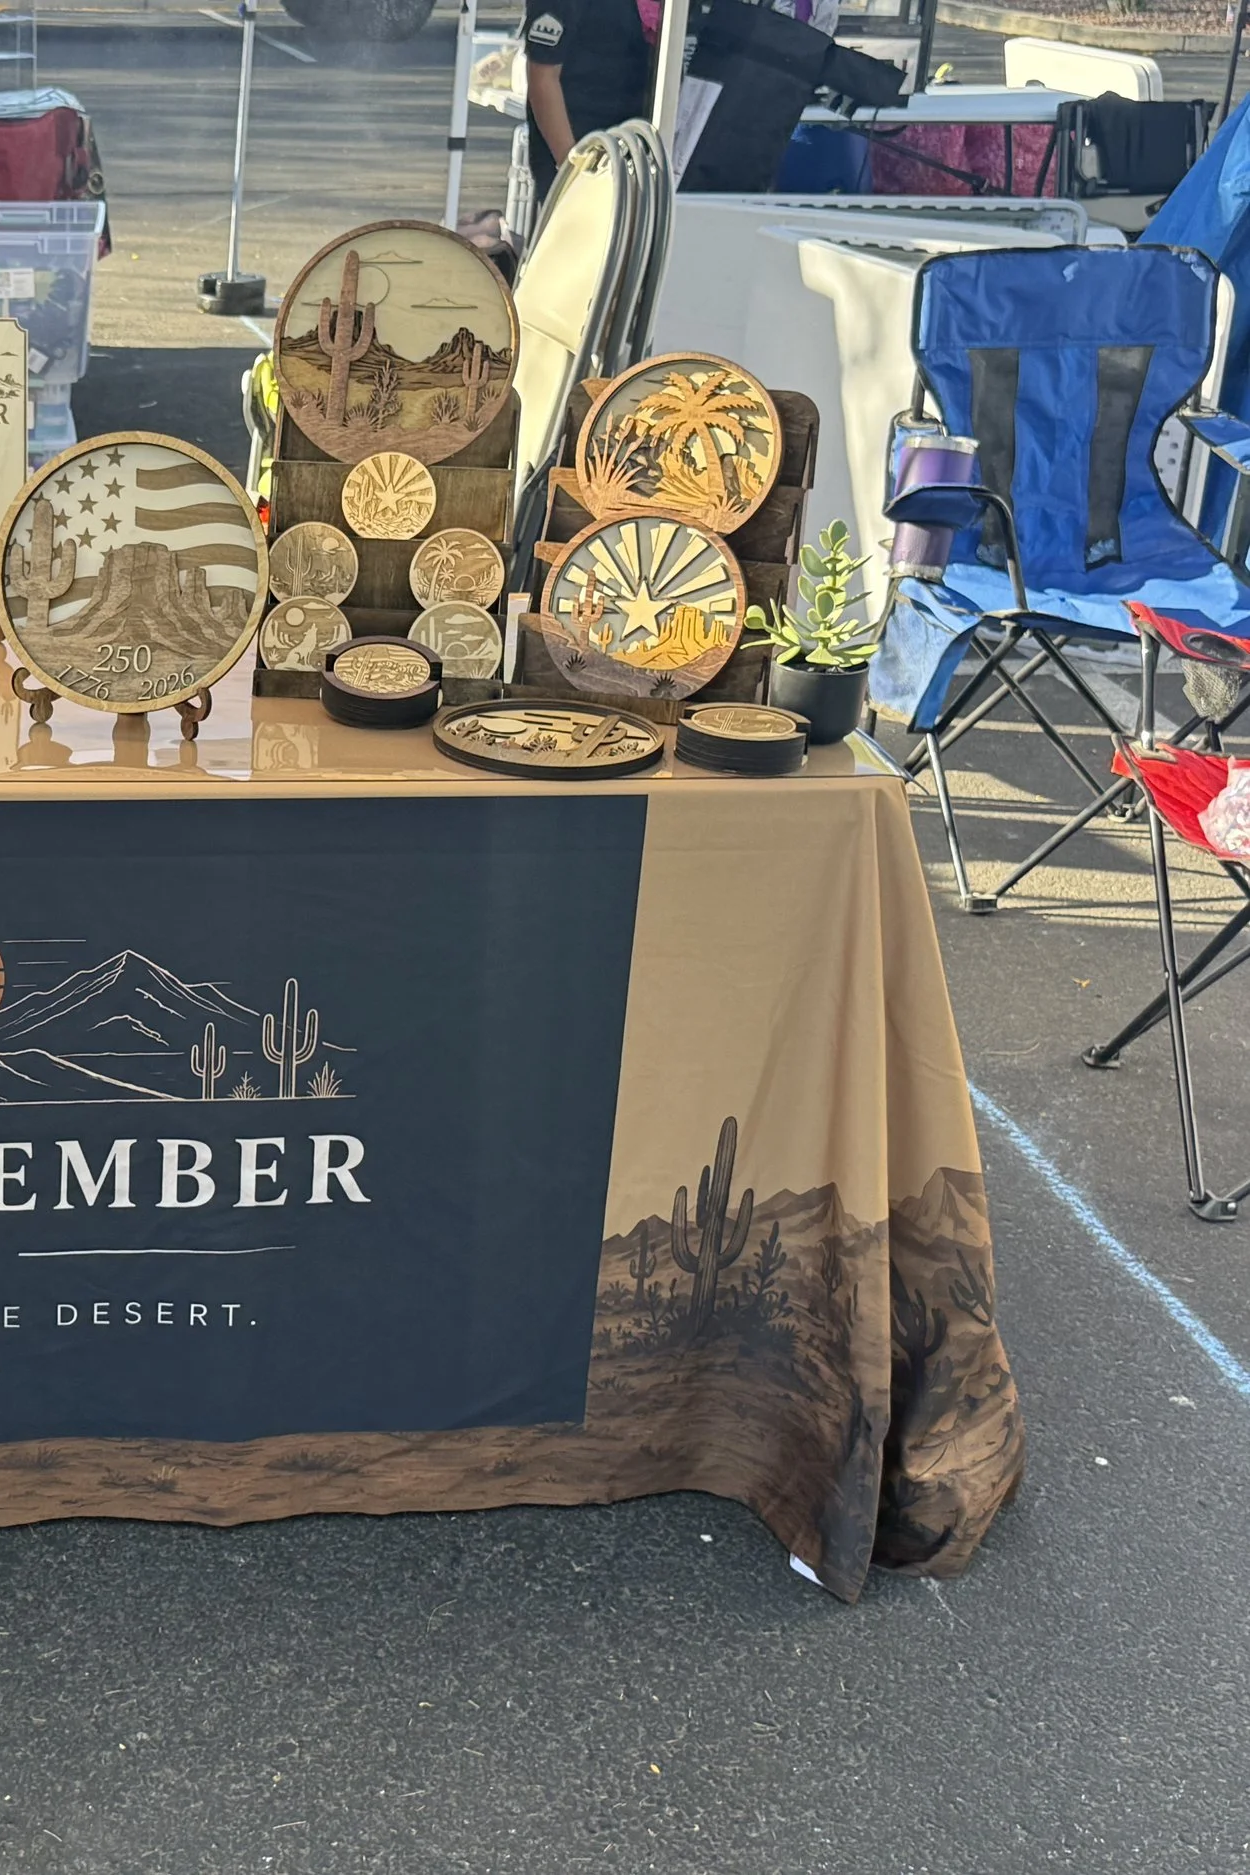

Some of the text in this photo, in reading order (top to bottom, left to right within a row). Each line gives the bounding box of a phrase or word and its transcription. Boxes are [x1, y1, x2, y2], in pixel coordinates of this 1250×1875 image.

[93, 644, 151, 673] 250
[54, 664, 195, 700] 1776 2026
[56, 1302, 257, 1327] DESERT.
